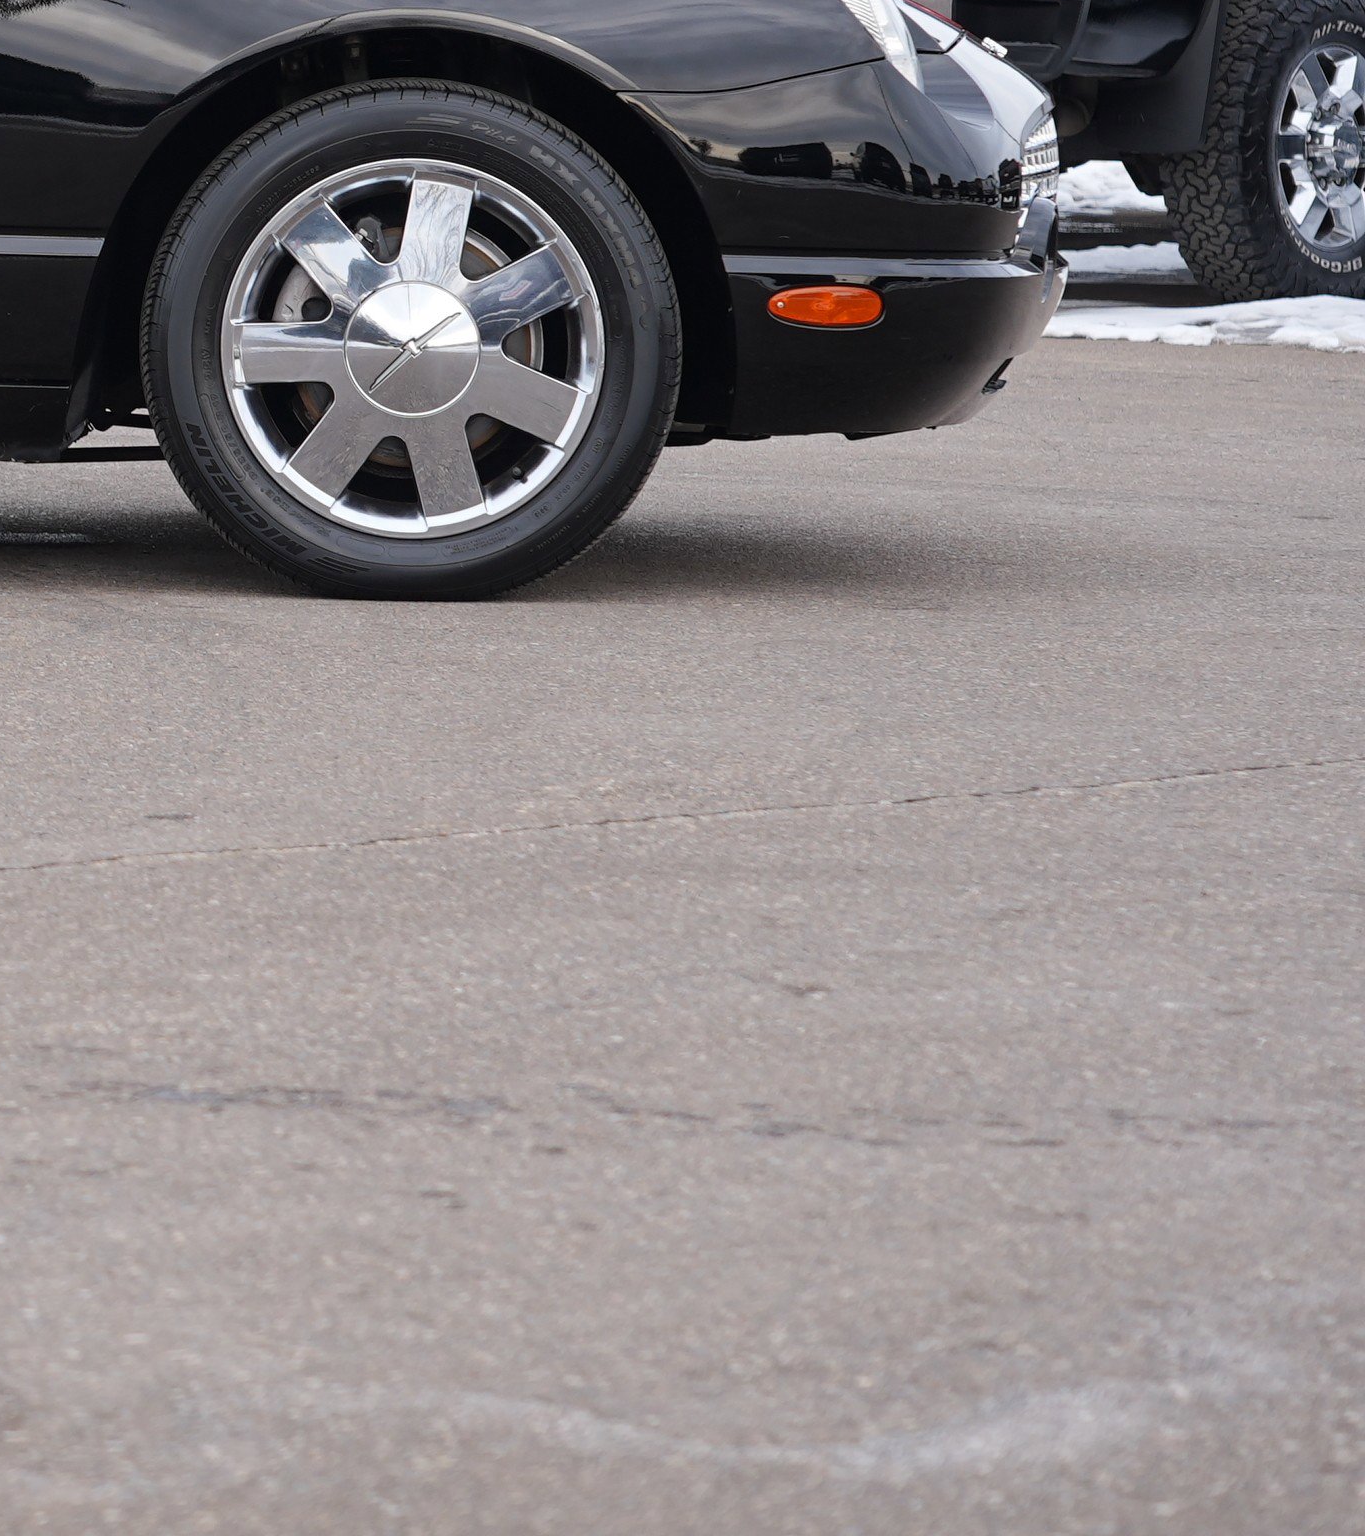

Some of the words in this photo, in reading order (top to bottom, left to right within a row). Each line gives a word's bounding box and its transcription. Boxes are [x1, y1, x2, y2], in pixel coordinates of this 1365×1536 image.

[470, 120, 521, 147] Pilot
[528, 145, 579, 187] HX
[185, 421, 307, 557] MICHELIN
